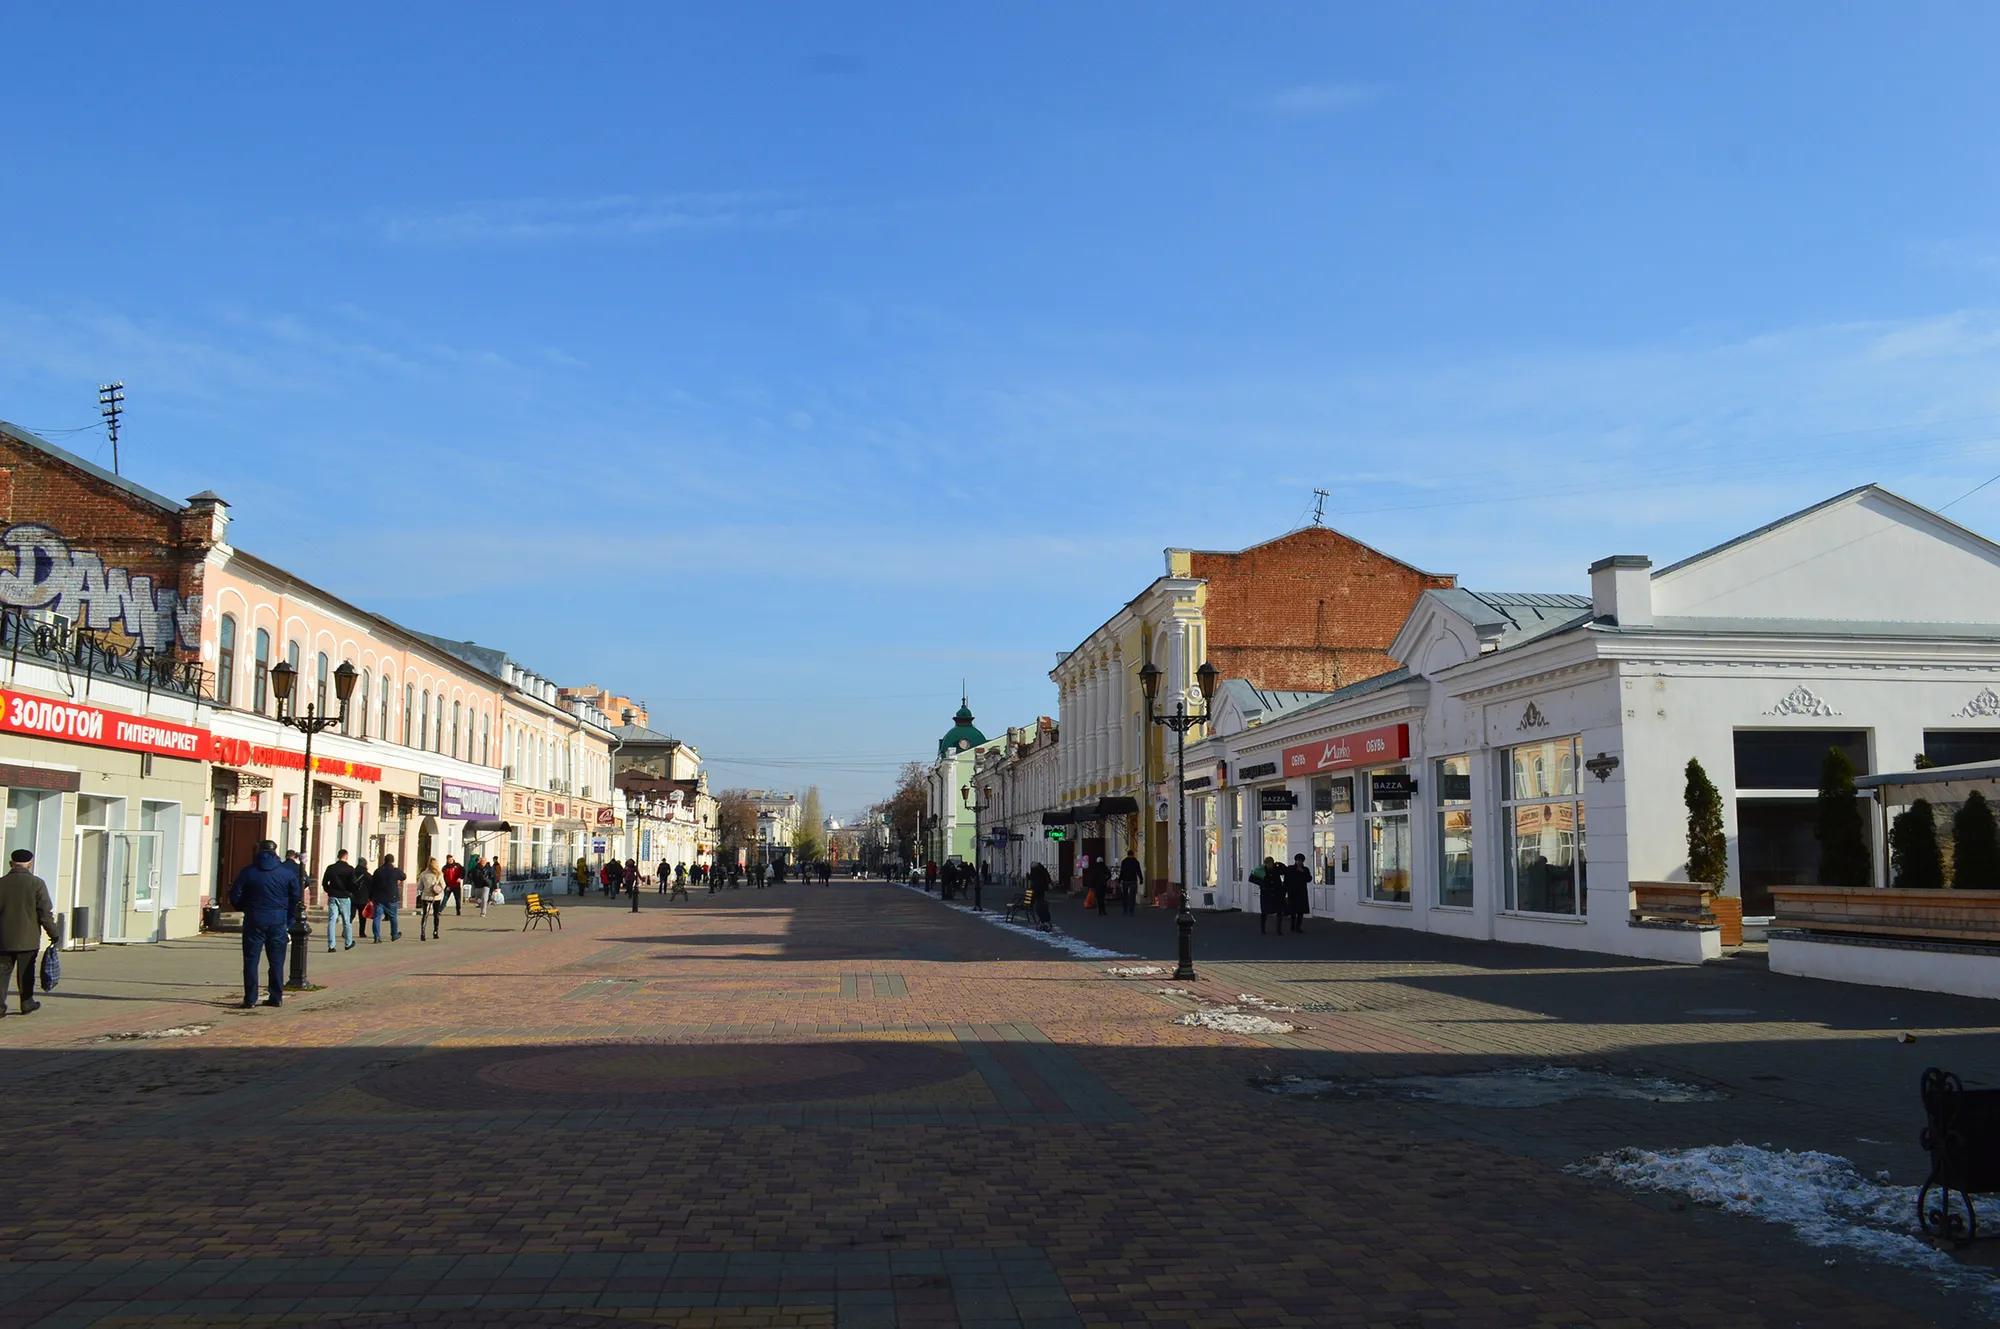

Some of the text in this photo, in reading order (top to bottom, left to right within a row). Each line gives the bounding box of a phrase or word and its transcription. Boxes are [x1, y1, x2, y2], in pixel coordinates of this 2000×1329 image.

[10, 698, 199, 752] ЗОЛОТОЙ ГИПЕРМАРКЕТ
[1366, 738, 1385, 753] ОБУВЬ
[1291, 753, 1306, 767] ОБУВЬ
[1374, 781, 1403, 789] BAZZA
